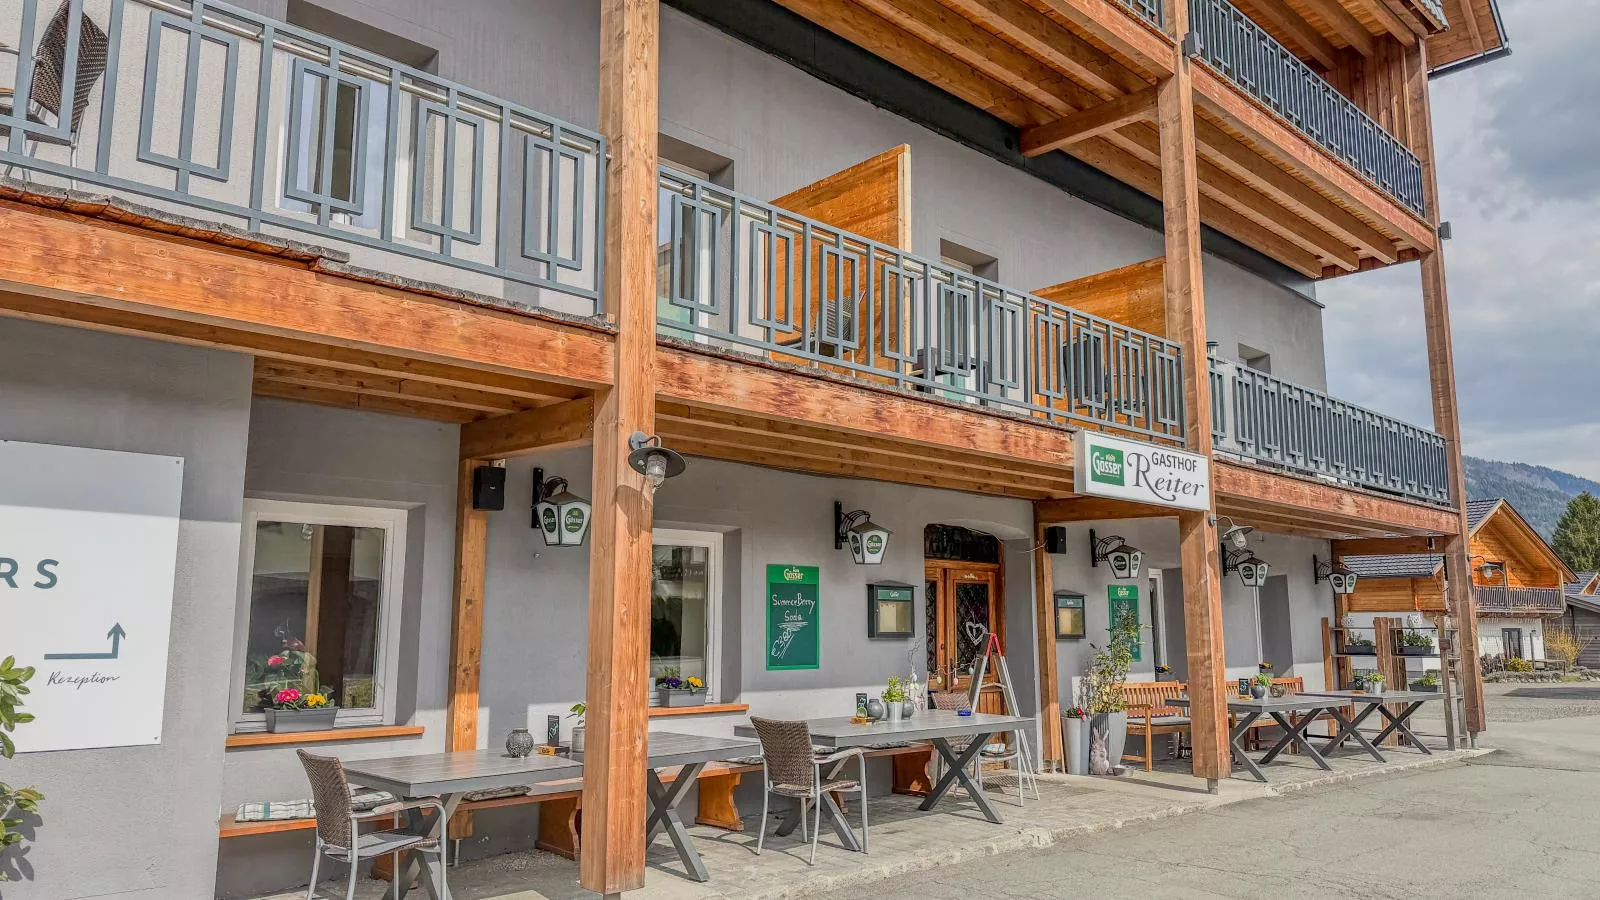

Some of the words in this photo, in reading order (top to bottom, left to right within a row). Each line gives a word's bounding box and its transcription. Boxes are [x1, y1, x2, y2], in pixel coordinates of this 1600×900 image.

[1093, 452, 1121, 475] Gösser
[1152, 452, 1197, 472] GASTHOF
[1127, 453, 1204, 501] Reiter
[47, 671, 120, 690] Rezeption
